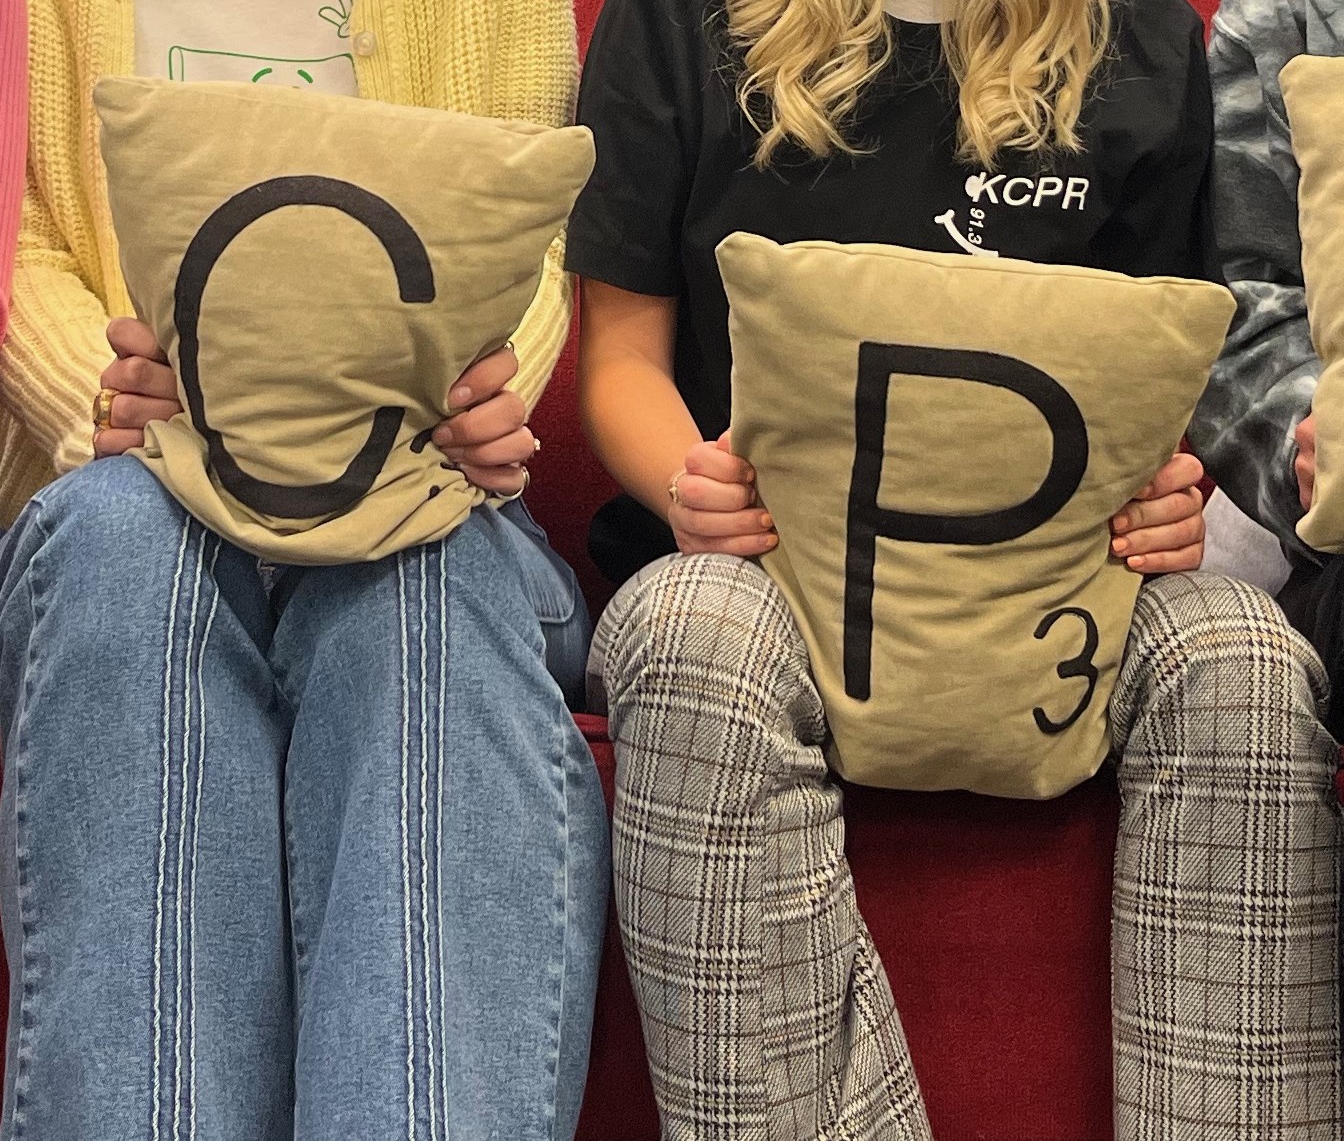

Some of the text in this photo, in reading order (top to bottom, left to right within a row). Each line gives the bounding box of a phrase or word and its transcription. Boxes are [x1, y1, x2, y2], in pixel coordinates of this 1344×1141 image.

[968, 208, 986, 245] 91.3
[970, 172, 1090, 210] KCPR
[174, 175, 435, 520] C
[843, 341, 1090, 702] P
[1032, 606, 1102, 734] 3
